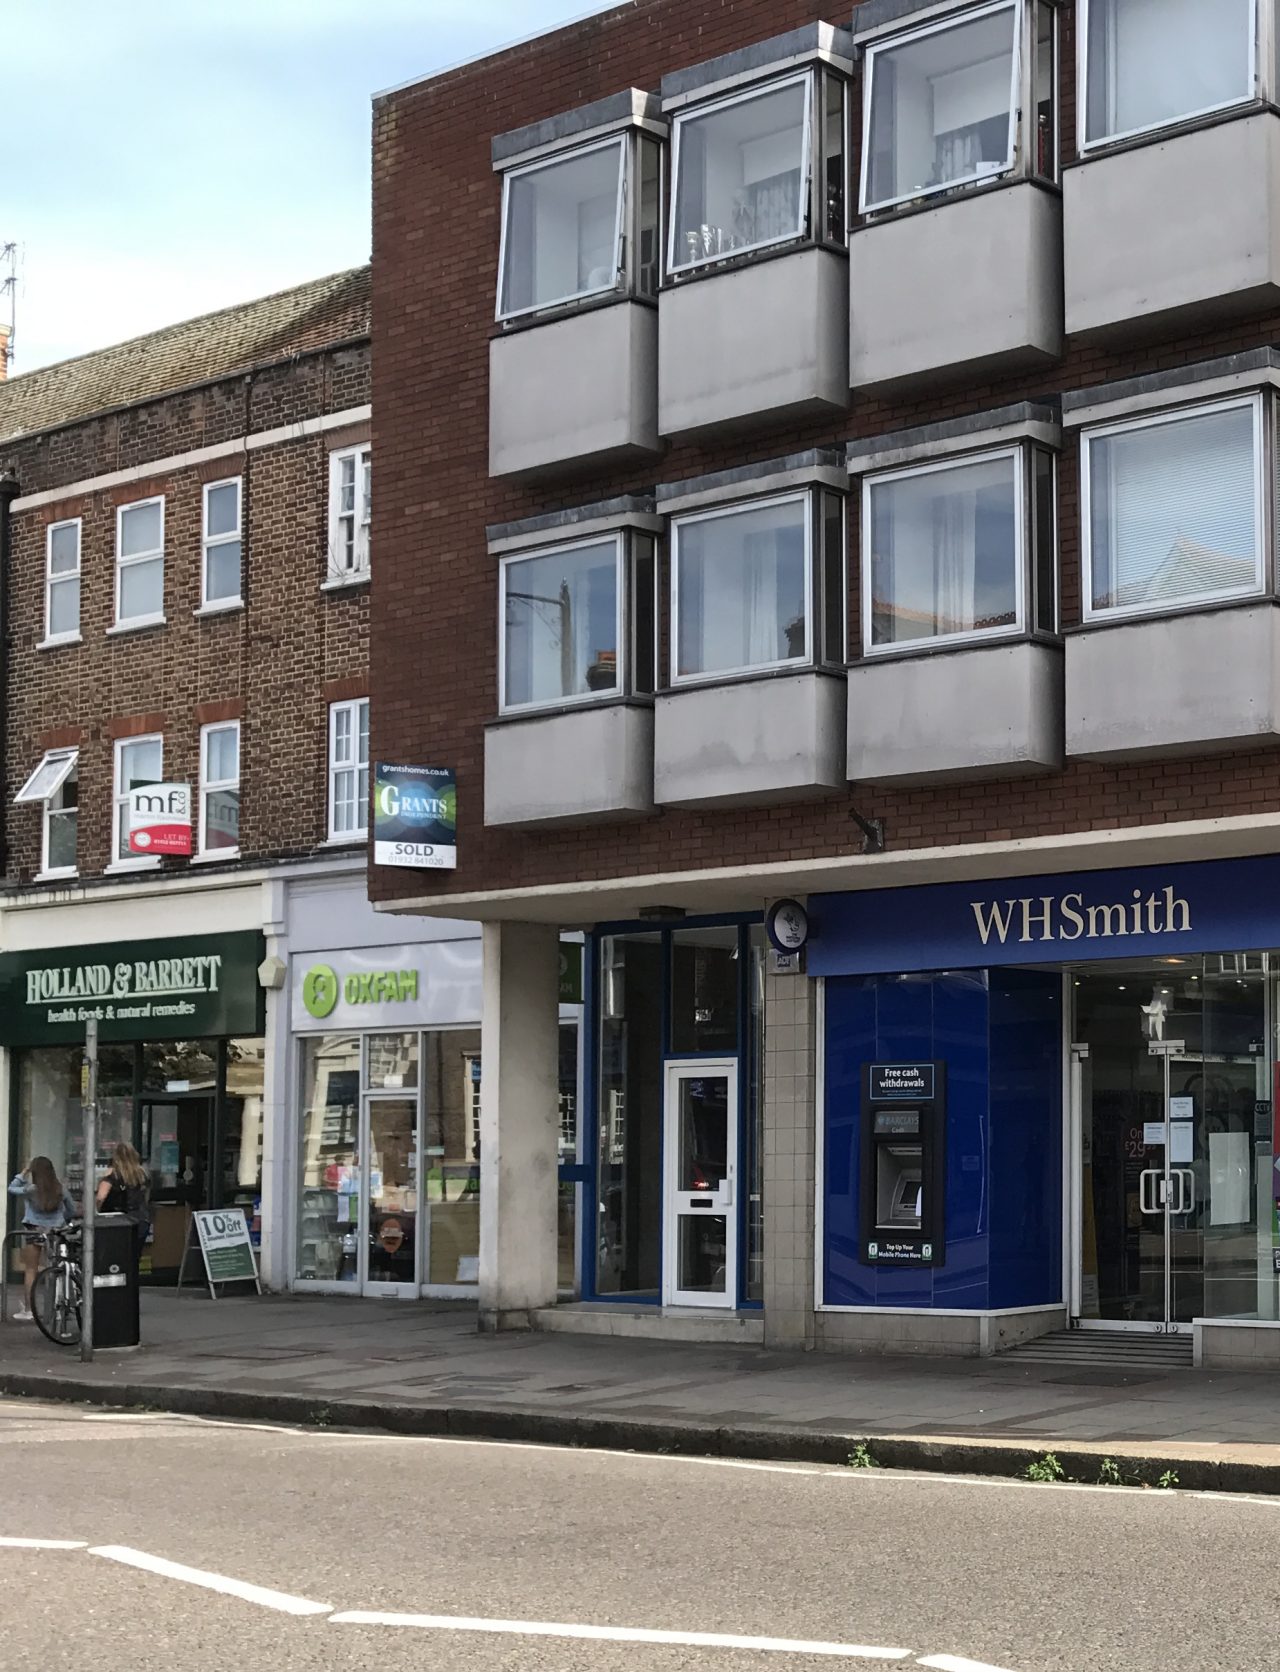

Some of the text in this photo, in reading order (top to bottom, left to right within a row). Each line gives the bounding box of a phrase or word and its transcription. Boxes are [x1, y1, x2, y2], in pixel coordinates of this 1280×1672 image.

[382, 765, 449, 776] grantshomes.co.uk
[135, 790, 179, 814] mf
[380, 785, 448, 816] GRANTS
[395, 843, 434, 857] SOLD
[970, 885, 1193, 945] WHSmith
[26, 955, 222, 1004] HOLLAND & BARRETT
[345, 970, 418, 1005] OXFAM
[48, 1001, 195, 1023] health foods & natural remedies
[879, 1078, 924, 1088] withdrawals
[884, 1067, 919, 1077] Free cash
[226, 1219, 242, 1232] off
